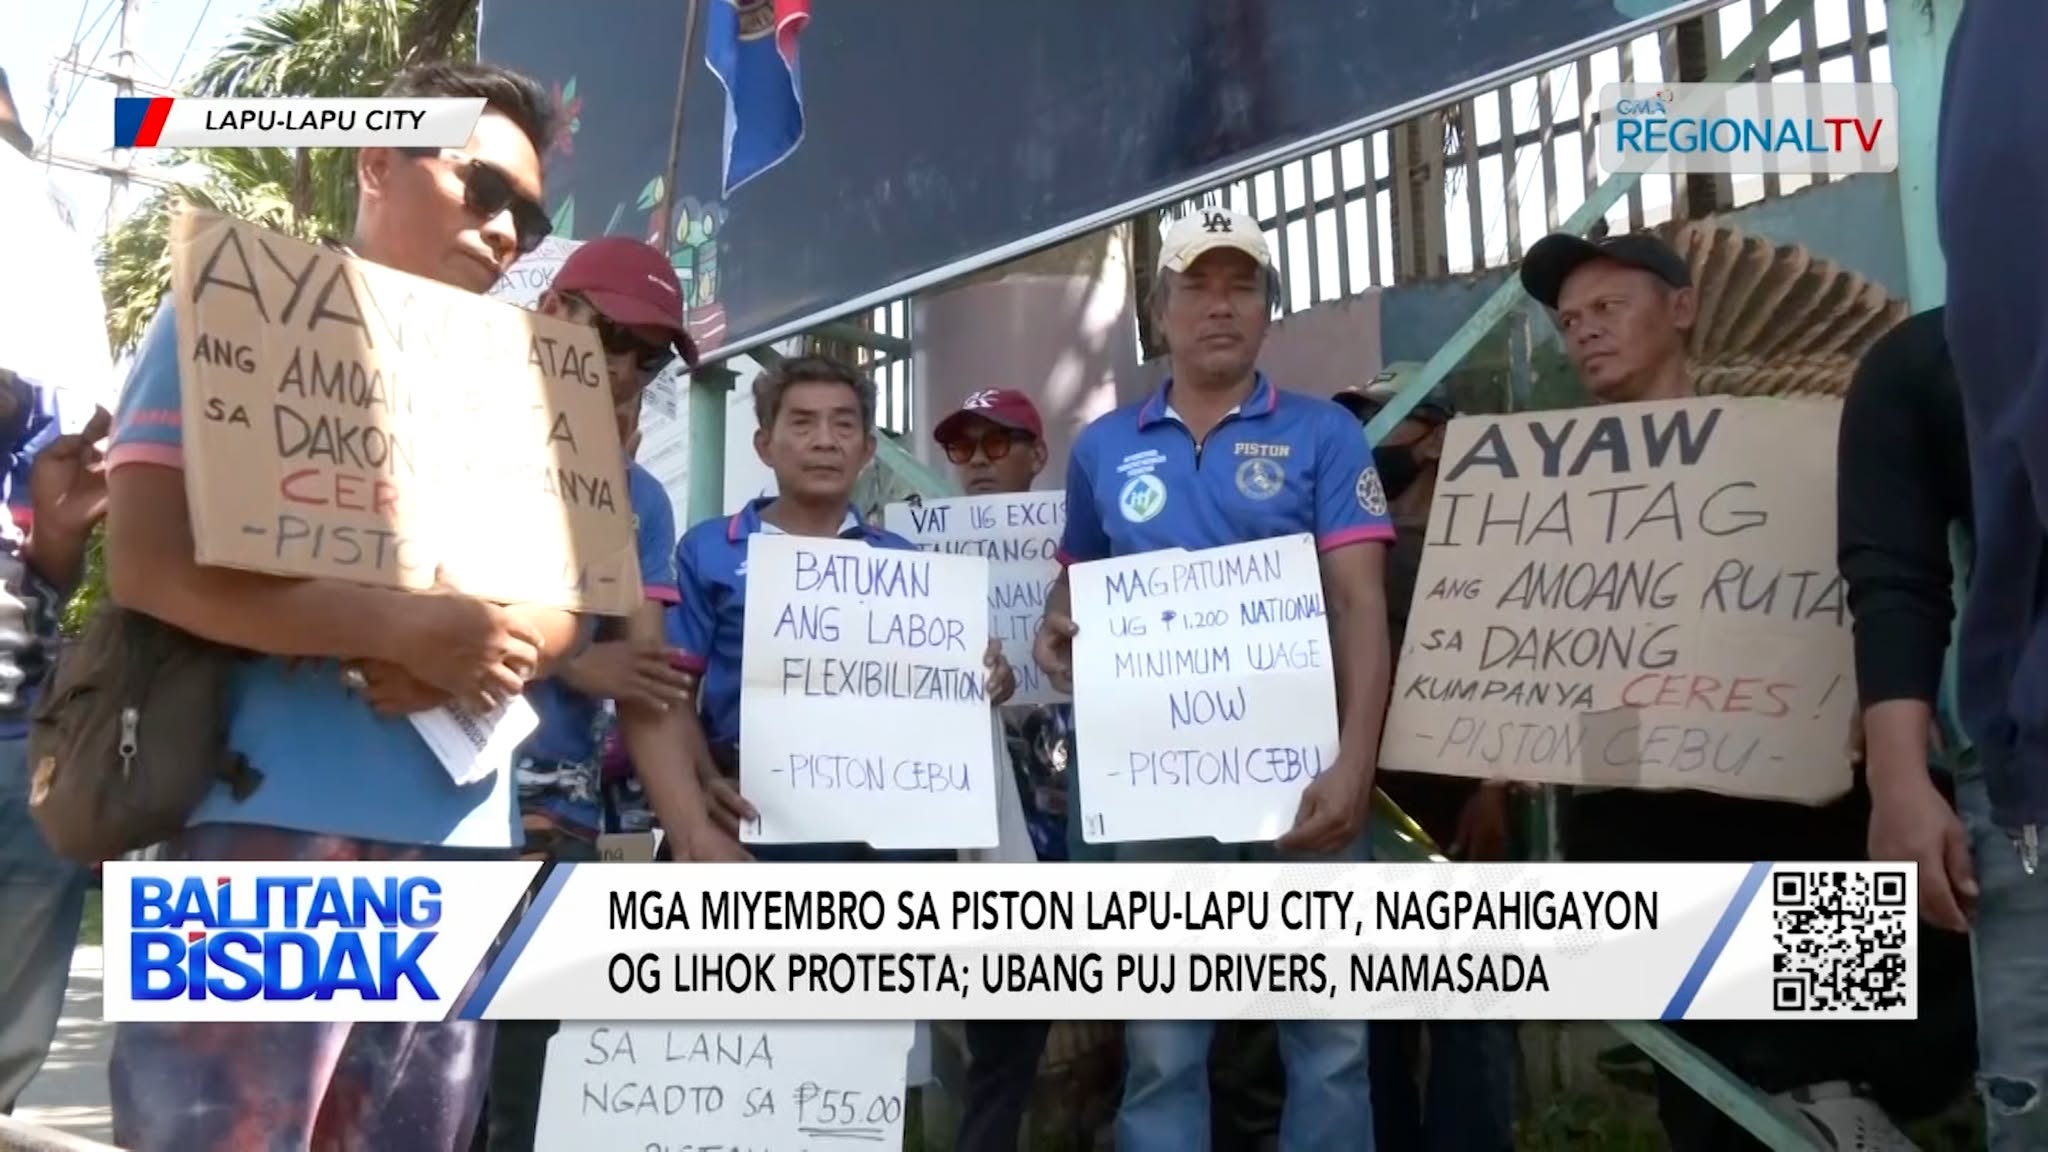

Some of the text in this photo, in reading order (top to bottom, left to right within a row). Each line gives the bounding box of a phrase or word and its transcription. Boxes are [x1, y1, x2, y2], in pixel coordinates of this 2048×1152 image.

[1202, 212, 1233, 232] LA
[193, 335, 413, 414] ANG AMOAN
[205, 397, 415, 475] SA DAKON
[1234, 442, 1291, 457] PISTON
[1444, 408, 1723, 483] AYAW
[281, 469, 398, 514] CER
[1427, 481, 1768, 547] IHATAG
[911, 505, 951, 534] VAT
[970, 505, 996, 529] UG
[796, 551, 930, 598] BATUKAN
[1105, 550, 1281, 605] MAGPATUMAN
[1426, 559, 1850, 628] ANG AMOANG RUTA
[774, 603, 966, 651] ANG LABOR
[1110, 616, 1146, 637] UG
[1240, 593, 1326, 626] NATIONAL
[1114, 639, 1321, 678] MINIMUM WAGE
[1421, 624, 1681, 672] SA DAKONG
[783, 657, 985, 702] FLEXIBILIZATION
[1404, 674, 1594, 709] KUMPANYA
[1169, 686, 1246, 730] NOW
[893, 760, 971, 793] CEBU
[585, 1027, 774, 1070] SA LANA
[582, 1082, 723, 1116] NGADTO
[743, 1087, 776, 1118] SA
